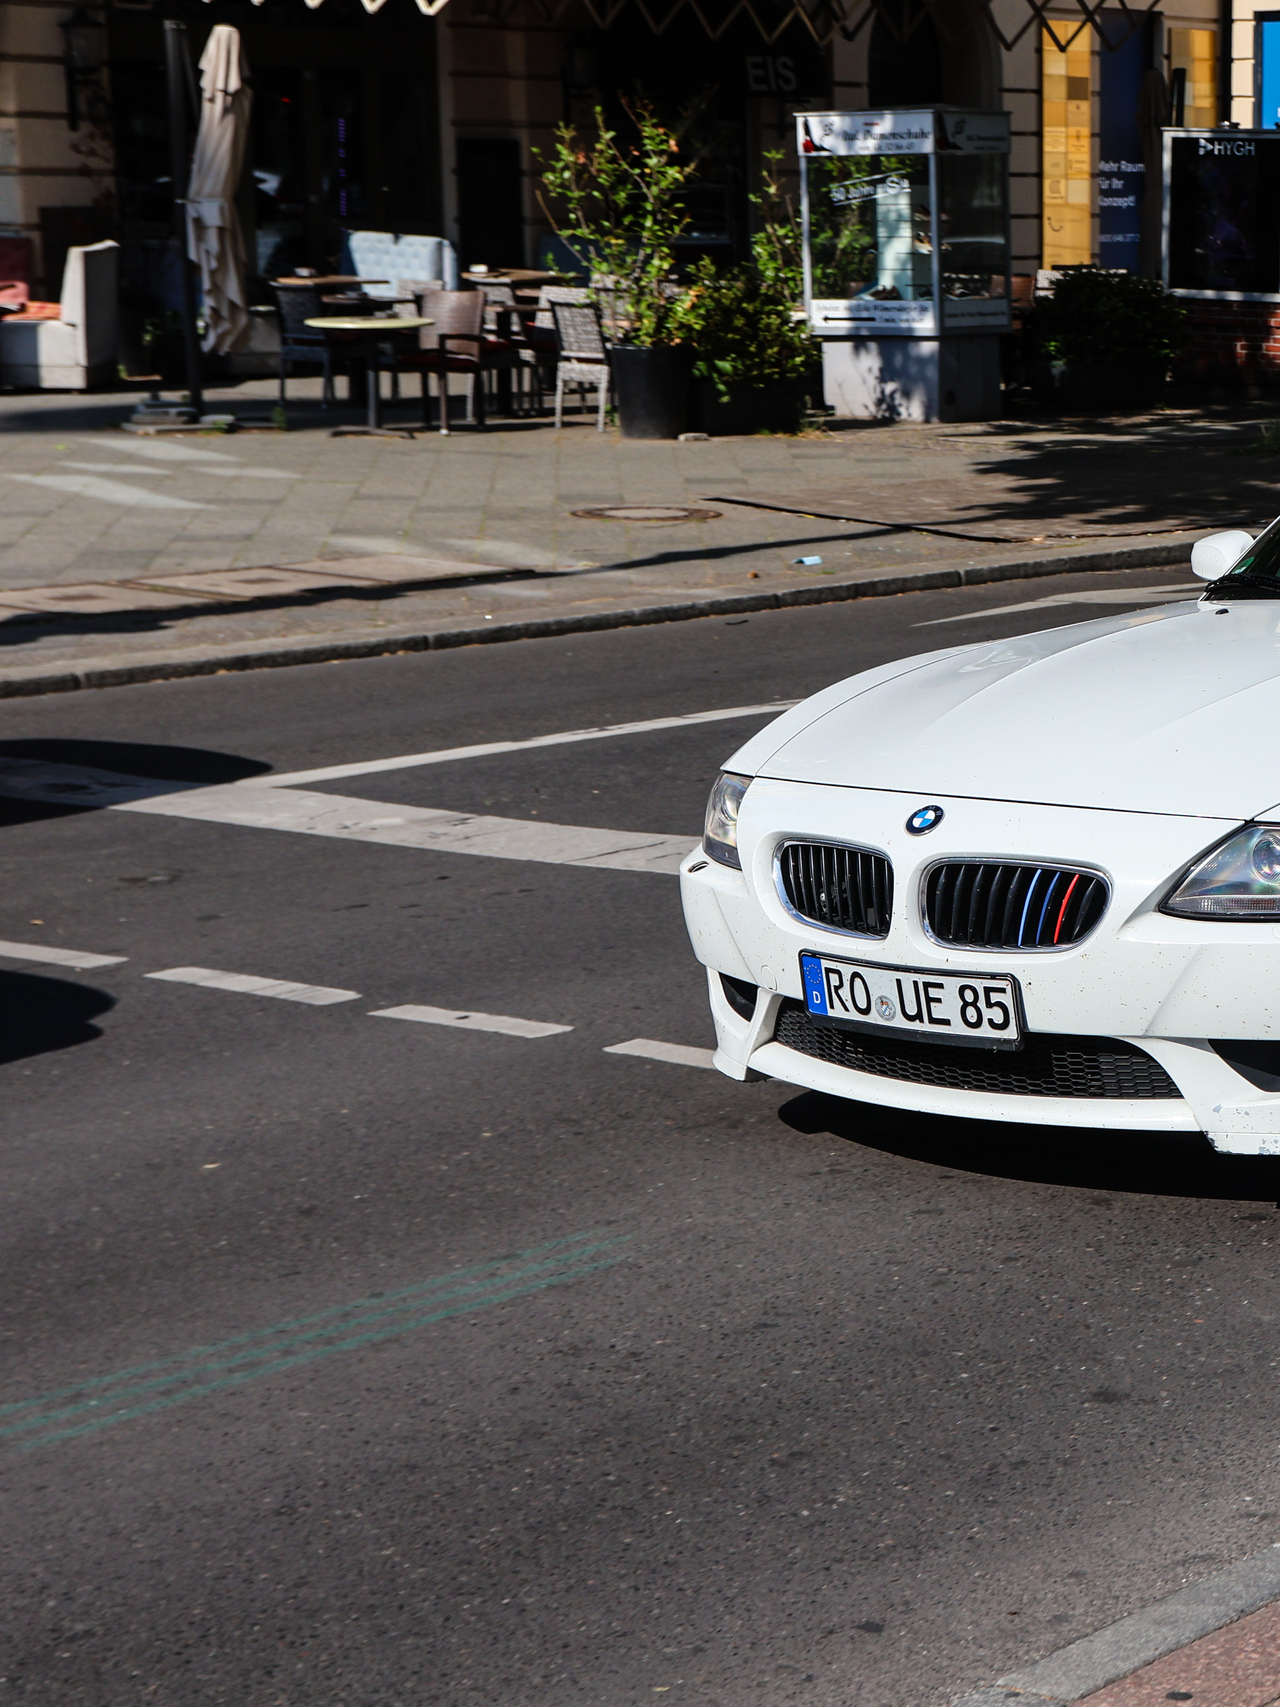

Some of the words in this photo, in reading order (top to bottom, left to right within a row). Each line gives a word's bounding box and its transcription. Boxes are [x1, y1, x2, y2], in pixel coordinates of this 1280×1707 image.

[745, 56, 798, 92] EIS
[1213, 141, 1256, 155] HYGH
[1120, 160, 1146, 172] Raum
[812, 990, 821, 1004] D
[824, 966, 872, 1016] RO
[895, 978, 952, 1026] UE
[958, 984, 1010, 1031] 85
